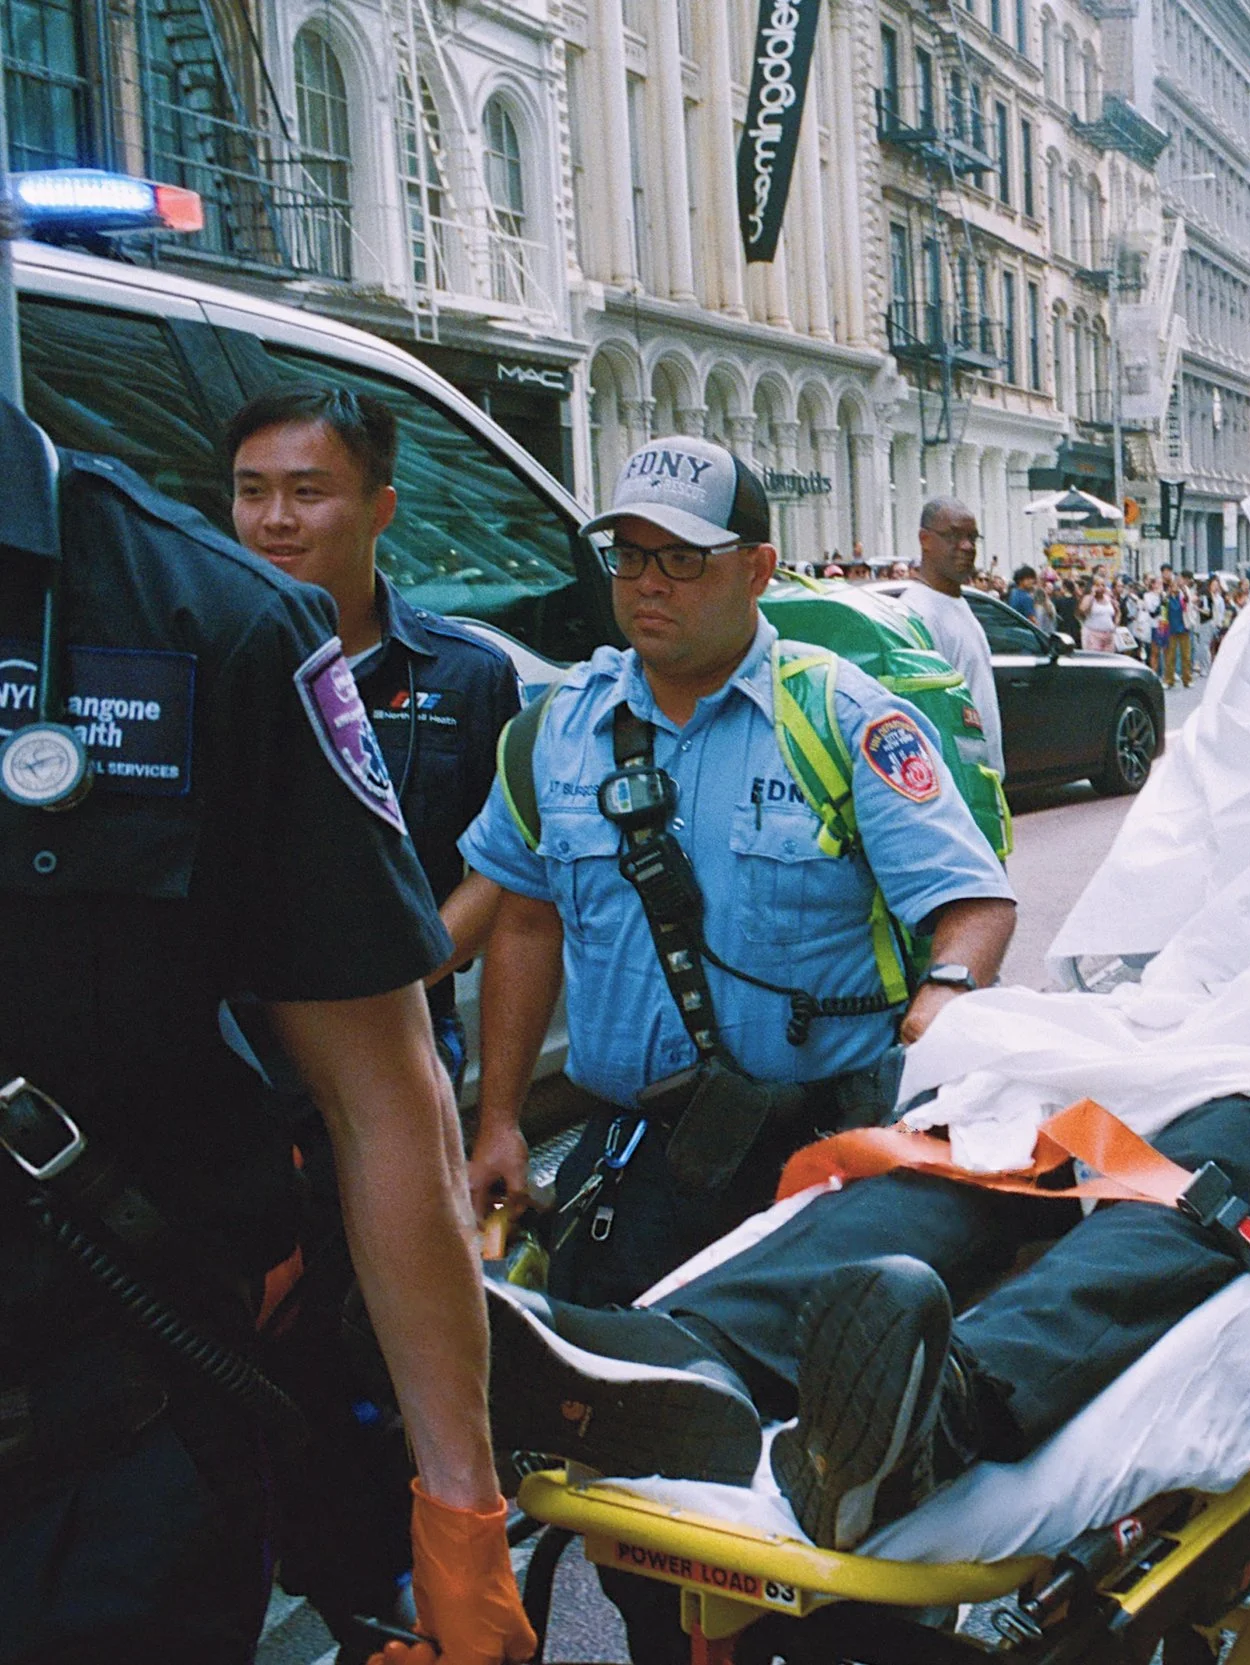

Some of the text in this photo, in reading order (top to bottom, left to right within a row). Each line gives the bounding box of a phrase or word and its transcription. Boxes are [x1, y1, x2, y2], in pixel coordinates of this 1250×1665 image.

[497, 363, 565, 389] MAC
[626, 451, 713, 483] FDNY
[0, 682, 36, 709] NY
[68, 695, 161, 722] angone
[73, 723, 122, 748] alth
[108, 762, 179, 779] SERVICES
[751, 777, 805, 803] FDN
[617, 1541, 757, 1594] POWER LOAD
